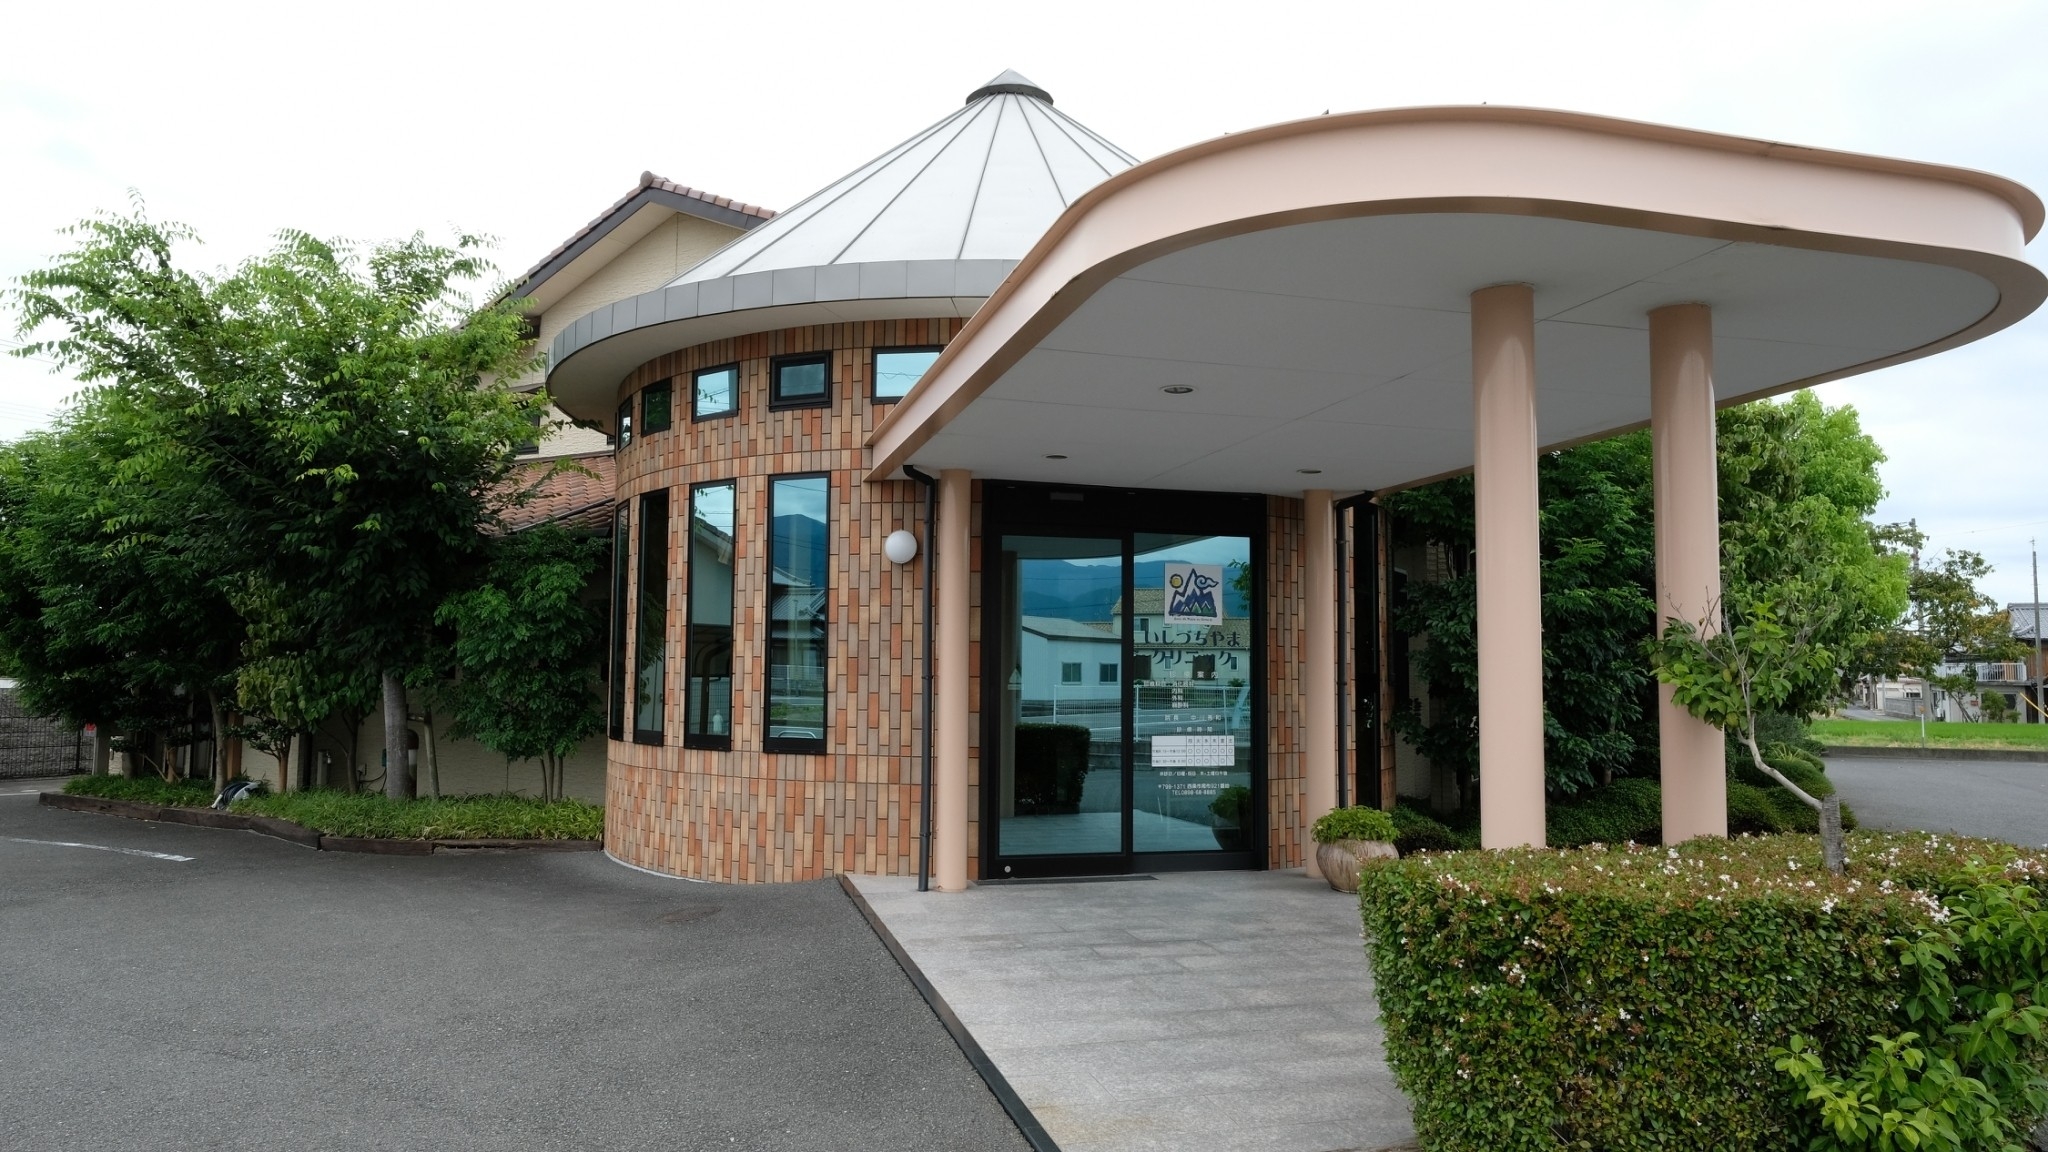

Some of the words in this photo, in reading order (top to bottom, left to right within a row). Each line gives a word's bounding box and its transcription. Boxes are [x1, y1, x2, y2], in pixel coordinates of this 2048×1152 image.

[1144, 630, 1240, 646] いしづちやま
